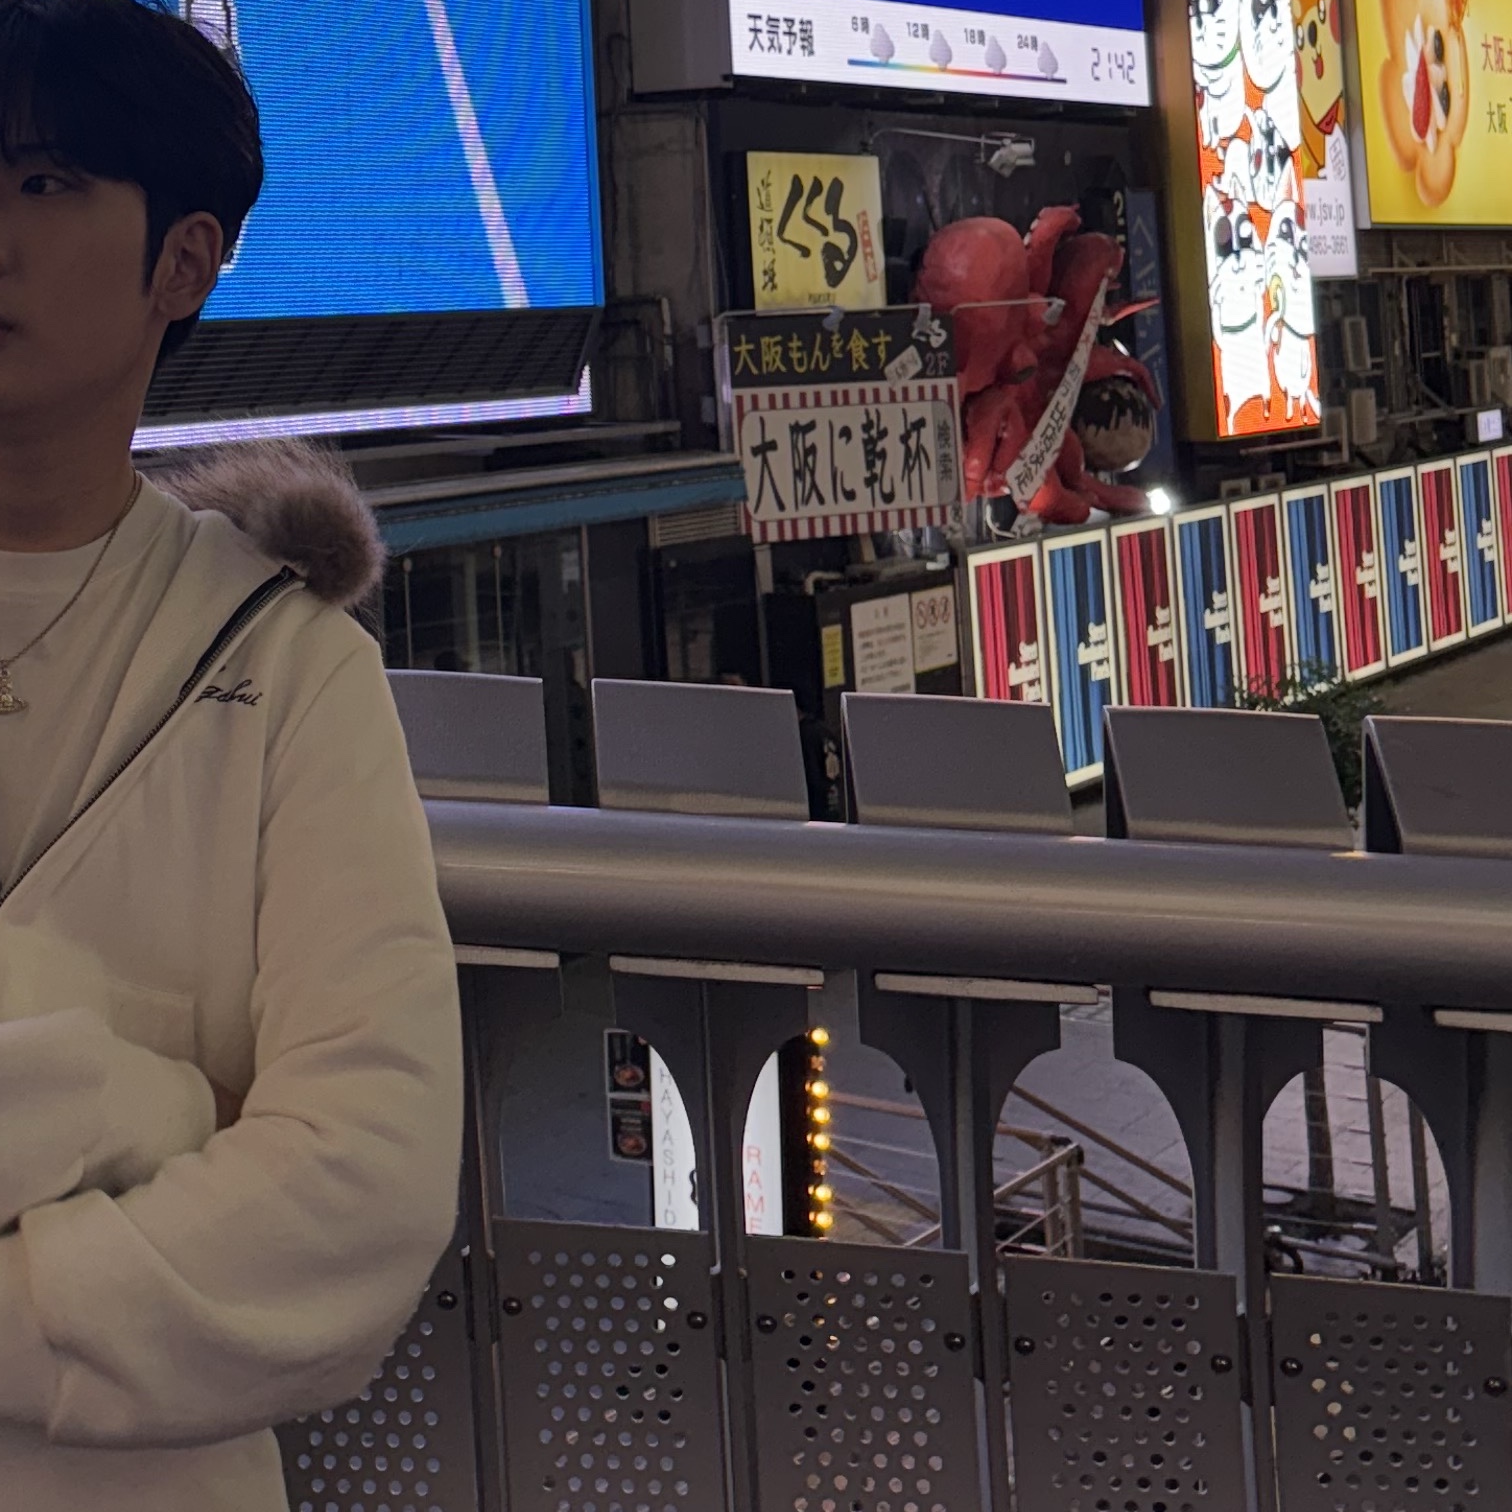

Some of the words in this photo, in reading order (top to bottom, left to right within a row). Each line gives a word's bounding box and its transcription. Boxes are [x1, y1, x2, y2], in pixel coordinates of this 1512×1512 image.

[746, 13, 816, 57] 天気予報
[751, 408, 931, 514] 大阪に乾杯
